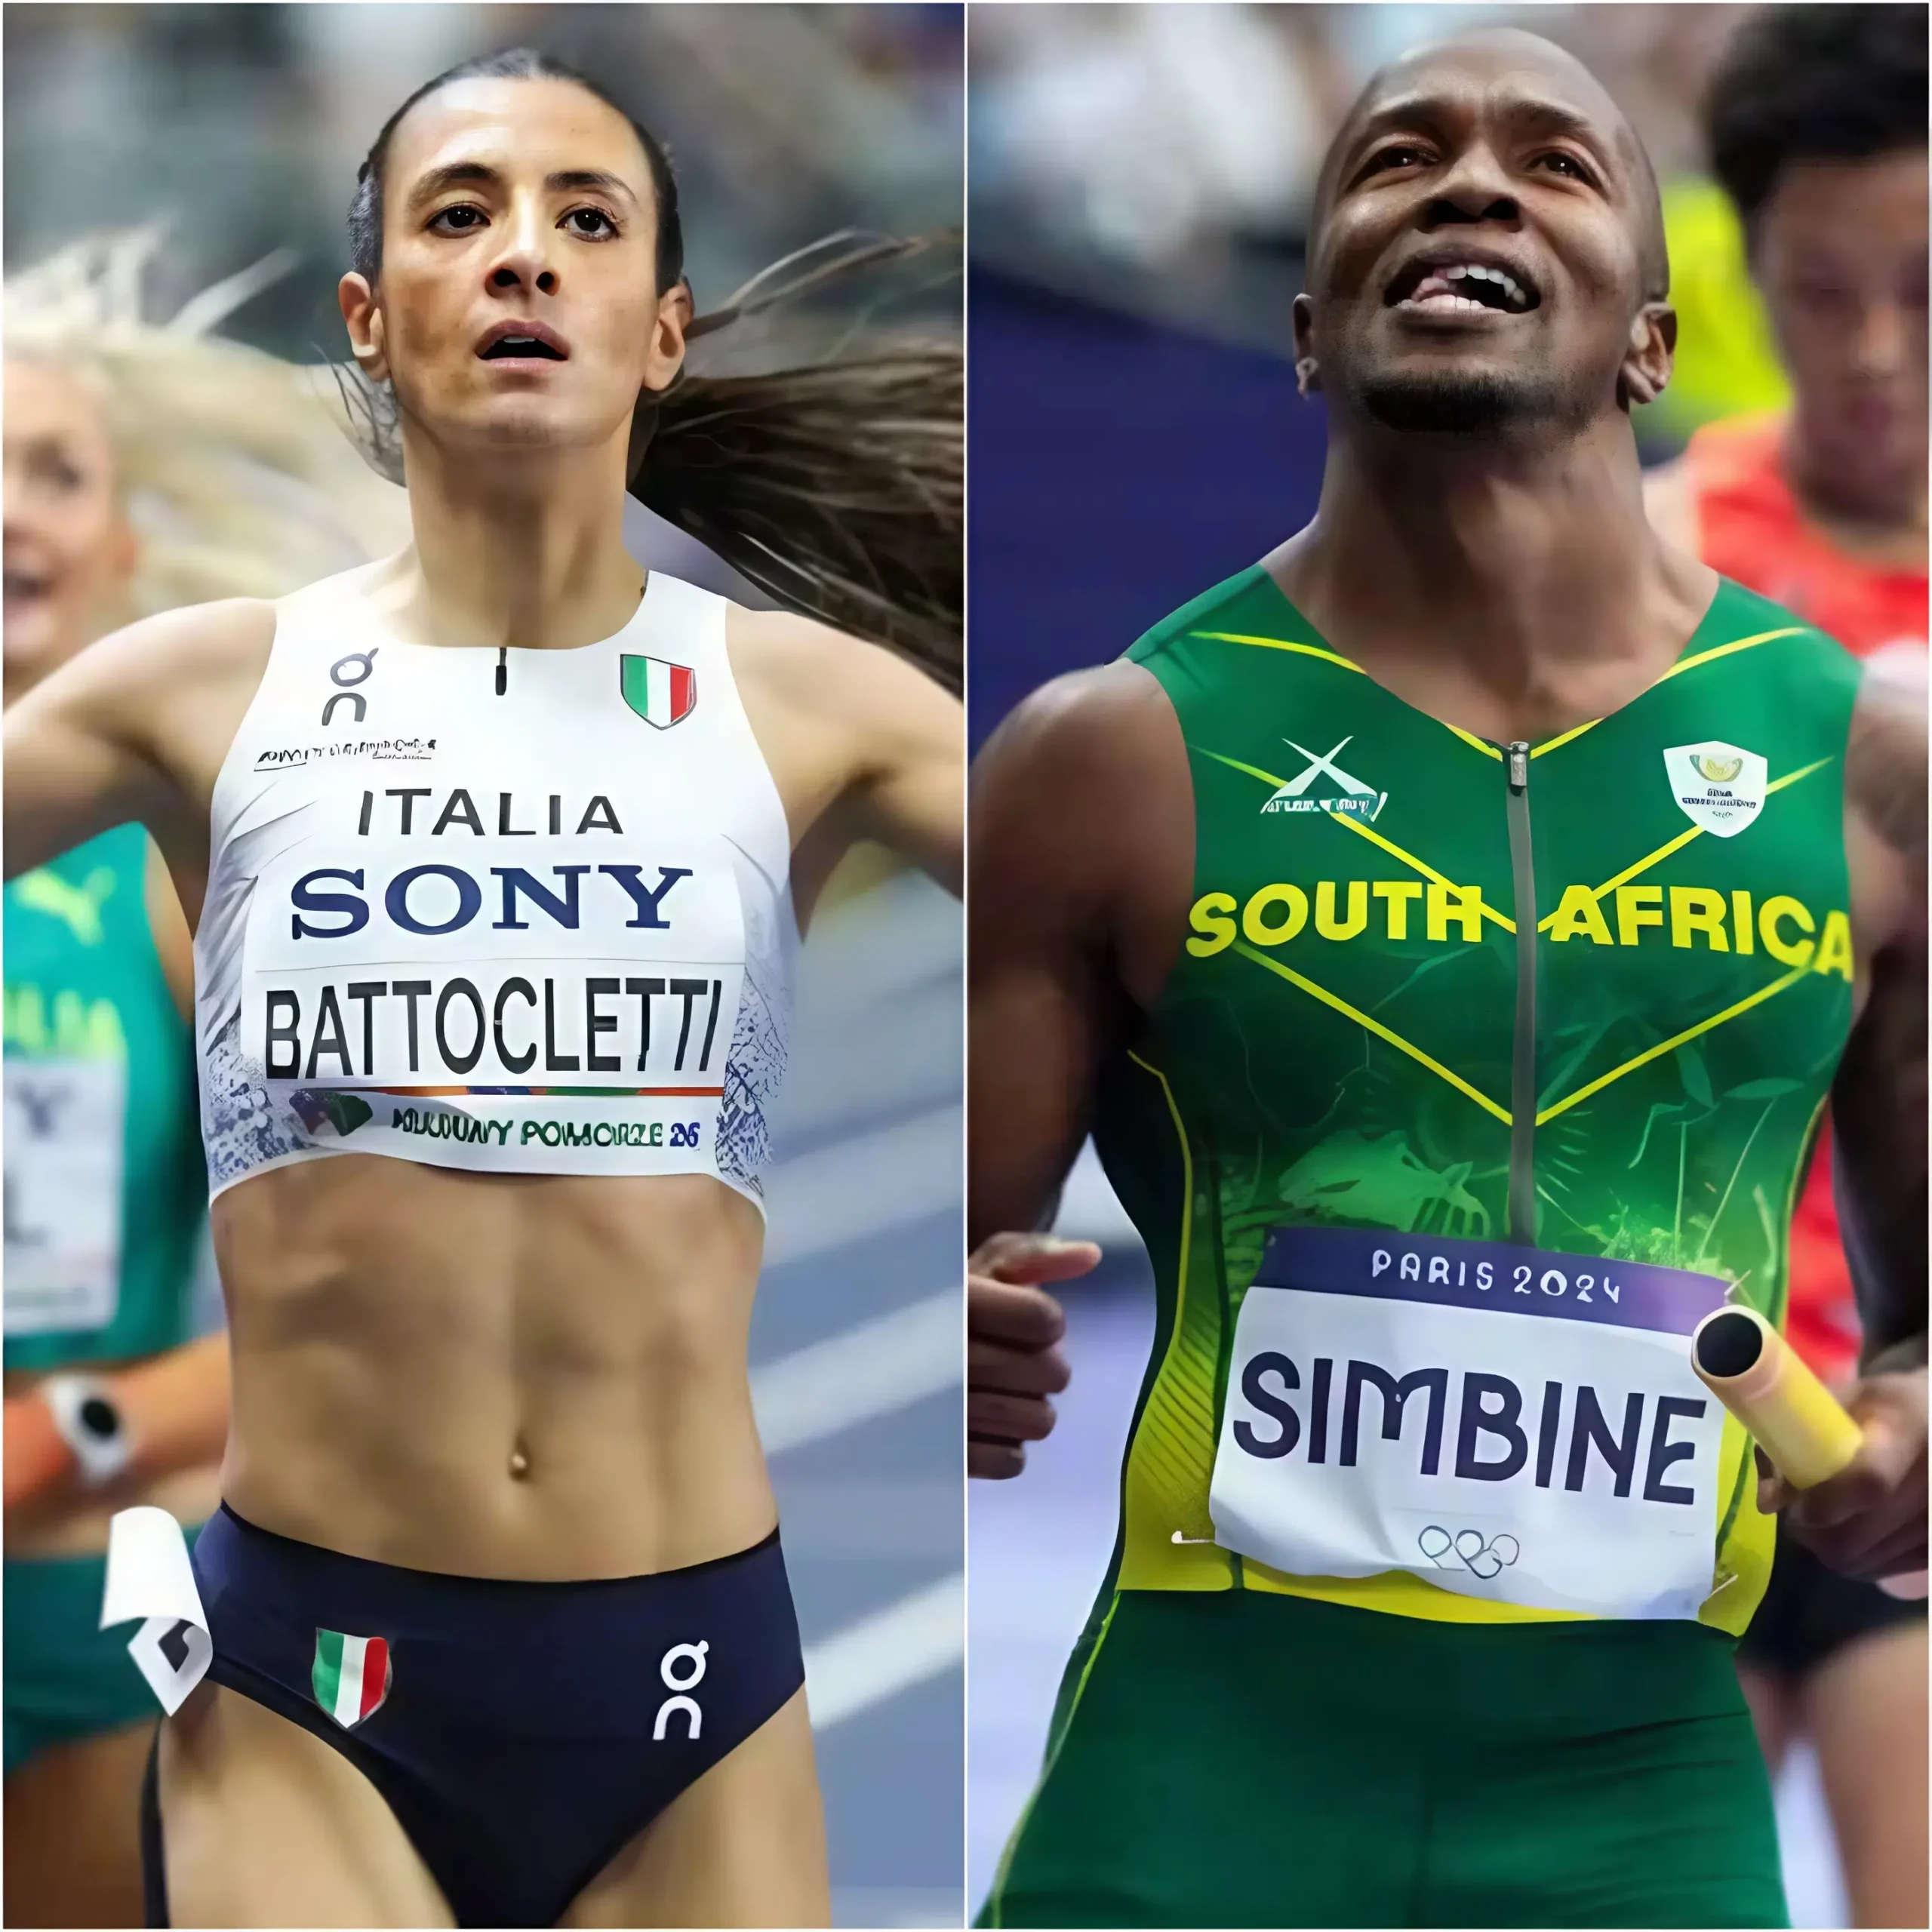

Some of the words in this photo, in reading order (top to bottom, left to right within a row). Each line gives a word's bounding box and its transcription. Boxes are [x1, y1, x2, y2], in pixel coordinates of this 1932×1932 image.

[358, 788, 624, 836] ITALIA
[291, 863, 693, 940] SONY
[1186, 881, 1482, 958] SOUTH
[1549, 884, 1854, 982] AFRICA
[266, 977, 722, 1080] BATTOCLETTI
[1371, 1248, 1494, 1291] PARIS
[1233, 1351, 1707, 1505] SIMBINE
